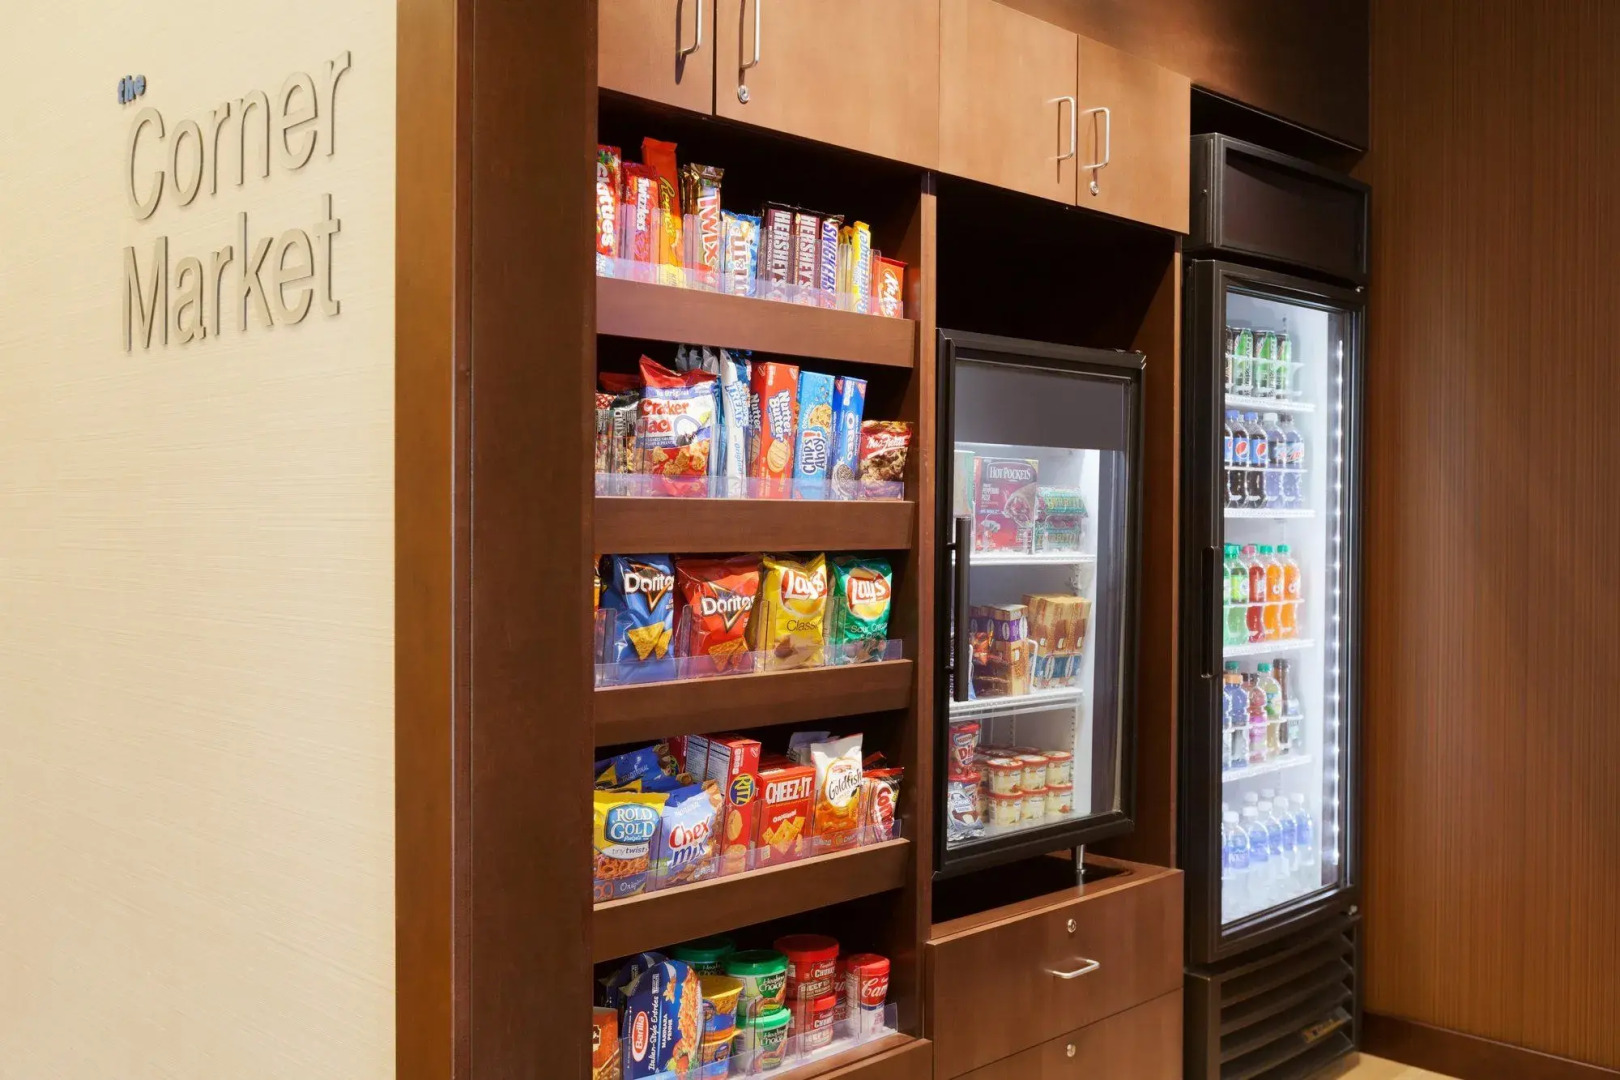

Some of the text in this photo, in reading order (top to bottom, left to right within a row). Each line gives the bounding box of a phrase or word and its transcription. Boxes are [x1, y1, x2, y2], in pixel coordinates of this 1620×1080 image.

[117, 74, 147, 105] the
[127, 50, 352, 221] Corner
[773, 211, 791, 287] HERSHEY'S
[799, 213, 816, 289] HERSHEY'S
[821, 223, 838, 294] SNICKERS
[122, 193, 341, 352] Market
[614, 410, 624, 437] KIND
[769, 397, 785, 443] Butter
[780, 390, 792, 437] Nutter
[846, 411, 856, 461] OREO
[801, 438, 816, 475] Chips
[851, 577, 887, 604] Lay's
[734, 775, 752, 805] RITZ
[828, 767, 862, 800] Goldfish
[610, 818, 656, 842] GOLD
[616, 807, 653, 822] ROLD
[669, 816, 710, 849] Chex
[635, 1015, 646, 1049] Barilla
